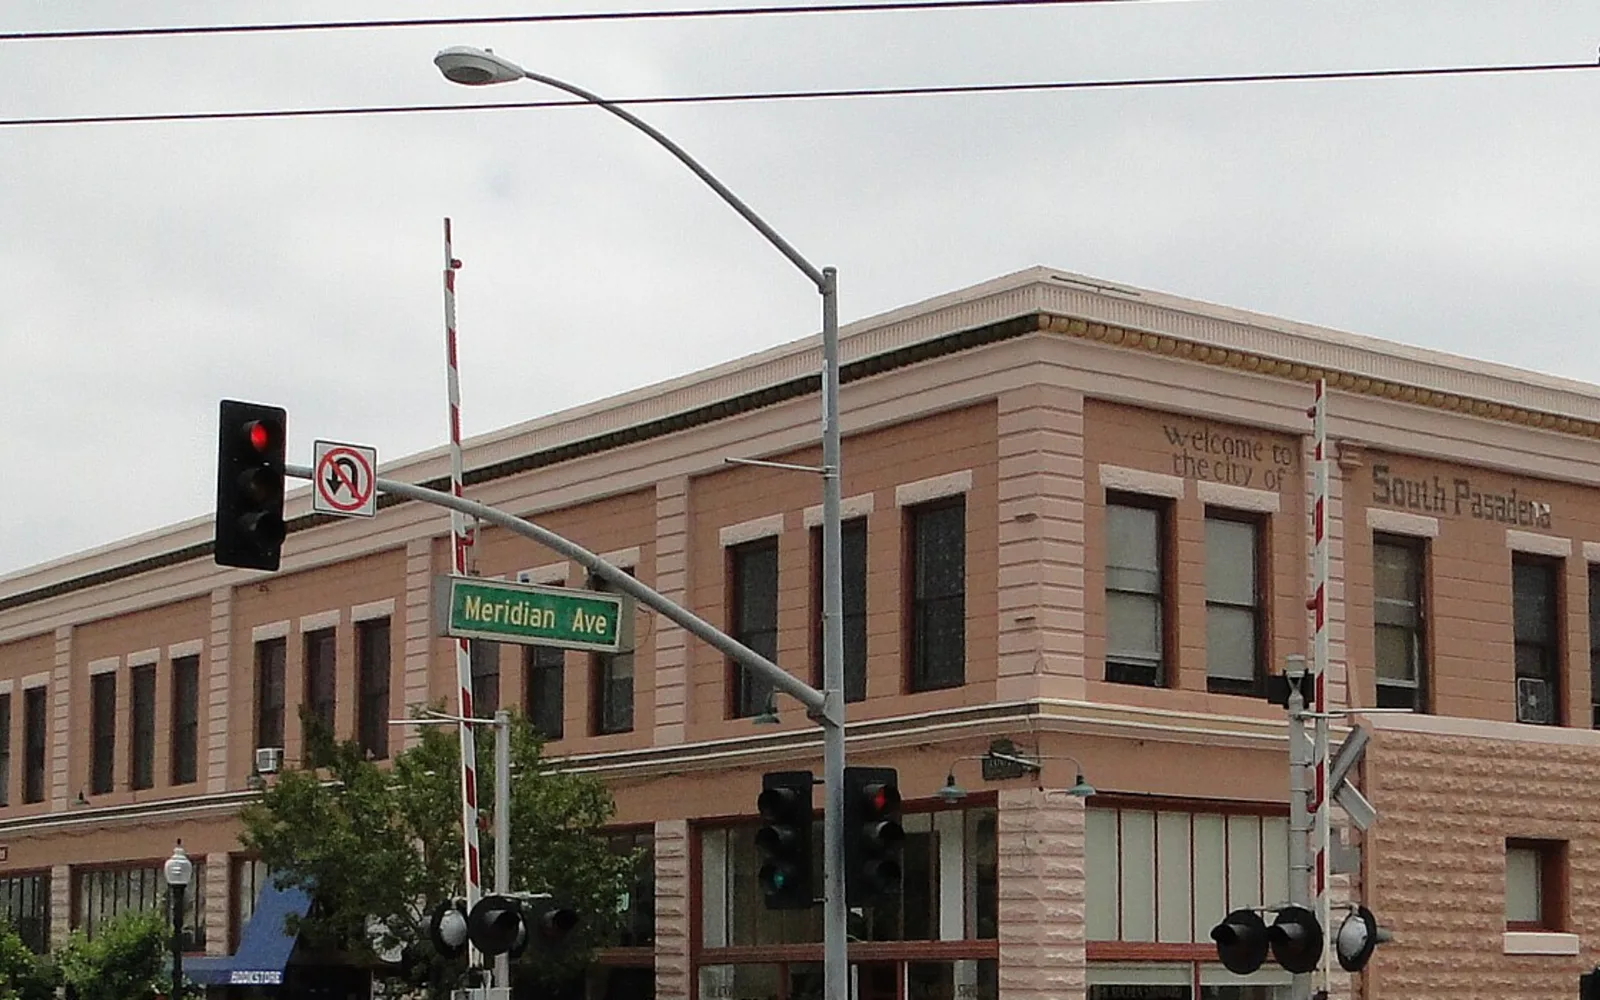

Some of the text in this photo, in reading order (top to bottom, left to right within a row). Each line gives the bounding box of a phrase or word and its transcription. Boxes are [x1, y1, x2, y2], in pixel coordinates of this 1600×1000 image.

[1173, 448, 1286, 490] the city of
[1272, 444, 1292, 466] to
[1372, 463, 1552, 528] South Pasadena
[465, 595, 608, 634] Meridian Ave
[231, 971, 282, 984] BOOKSTORE
